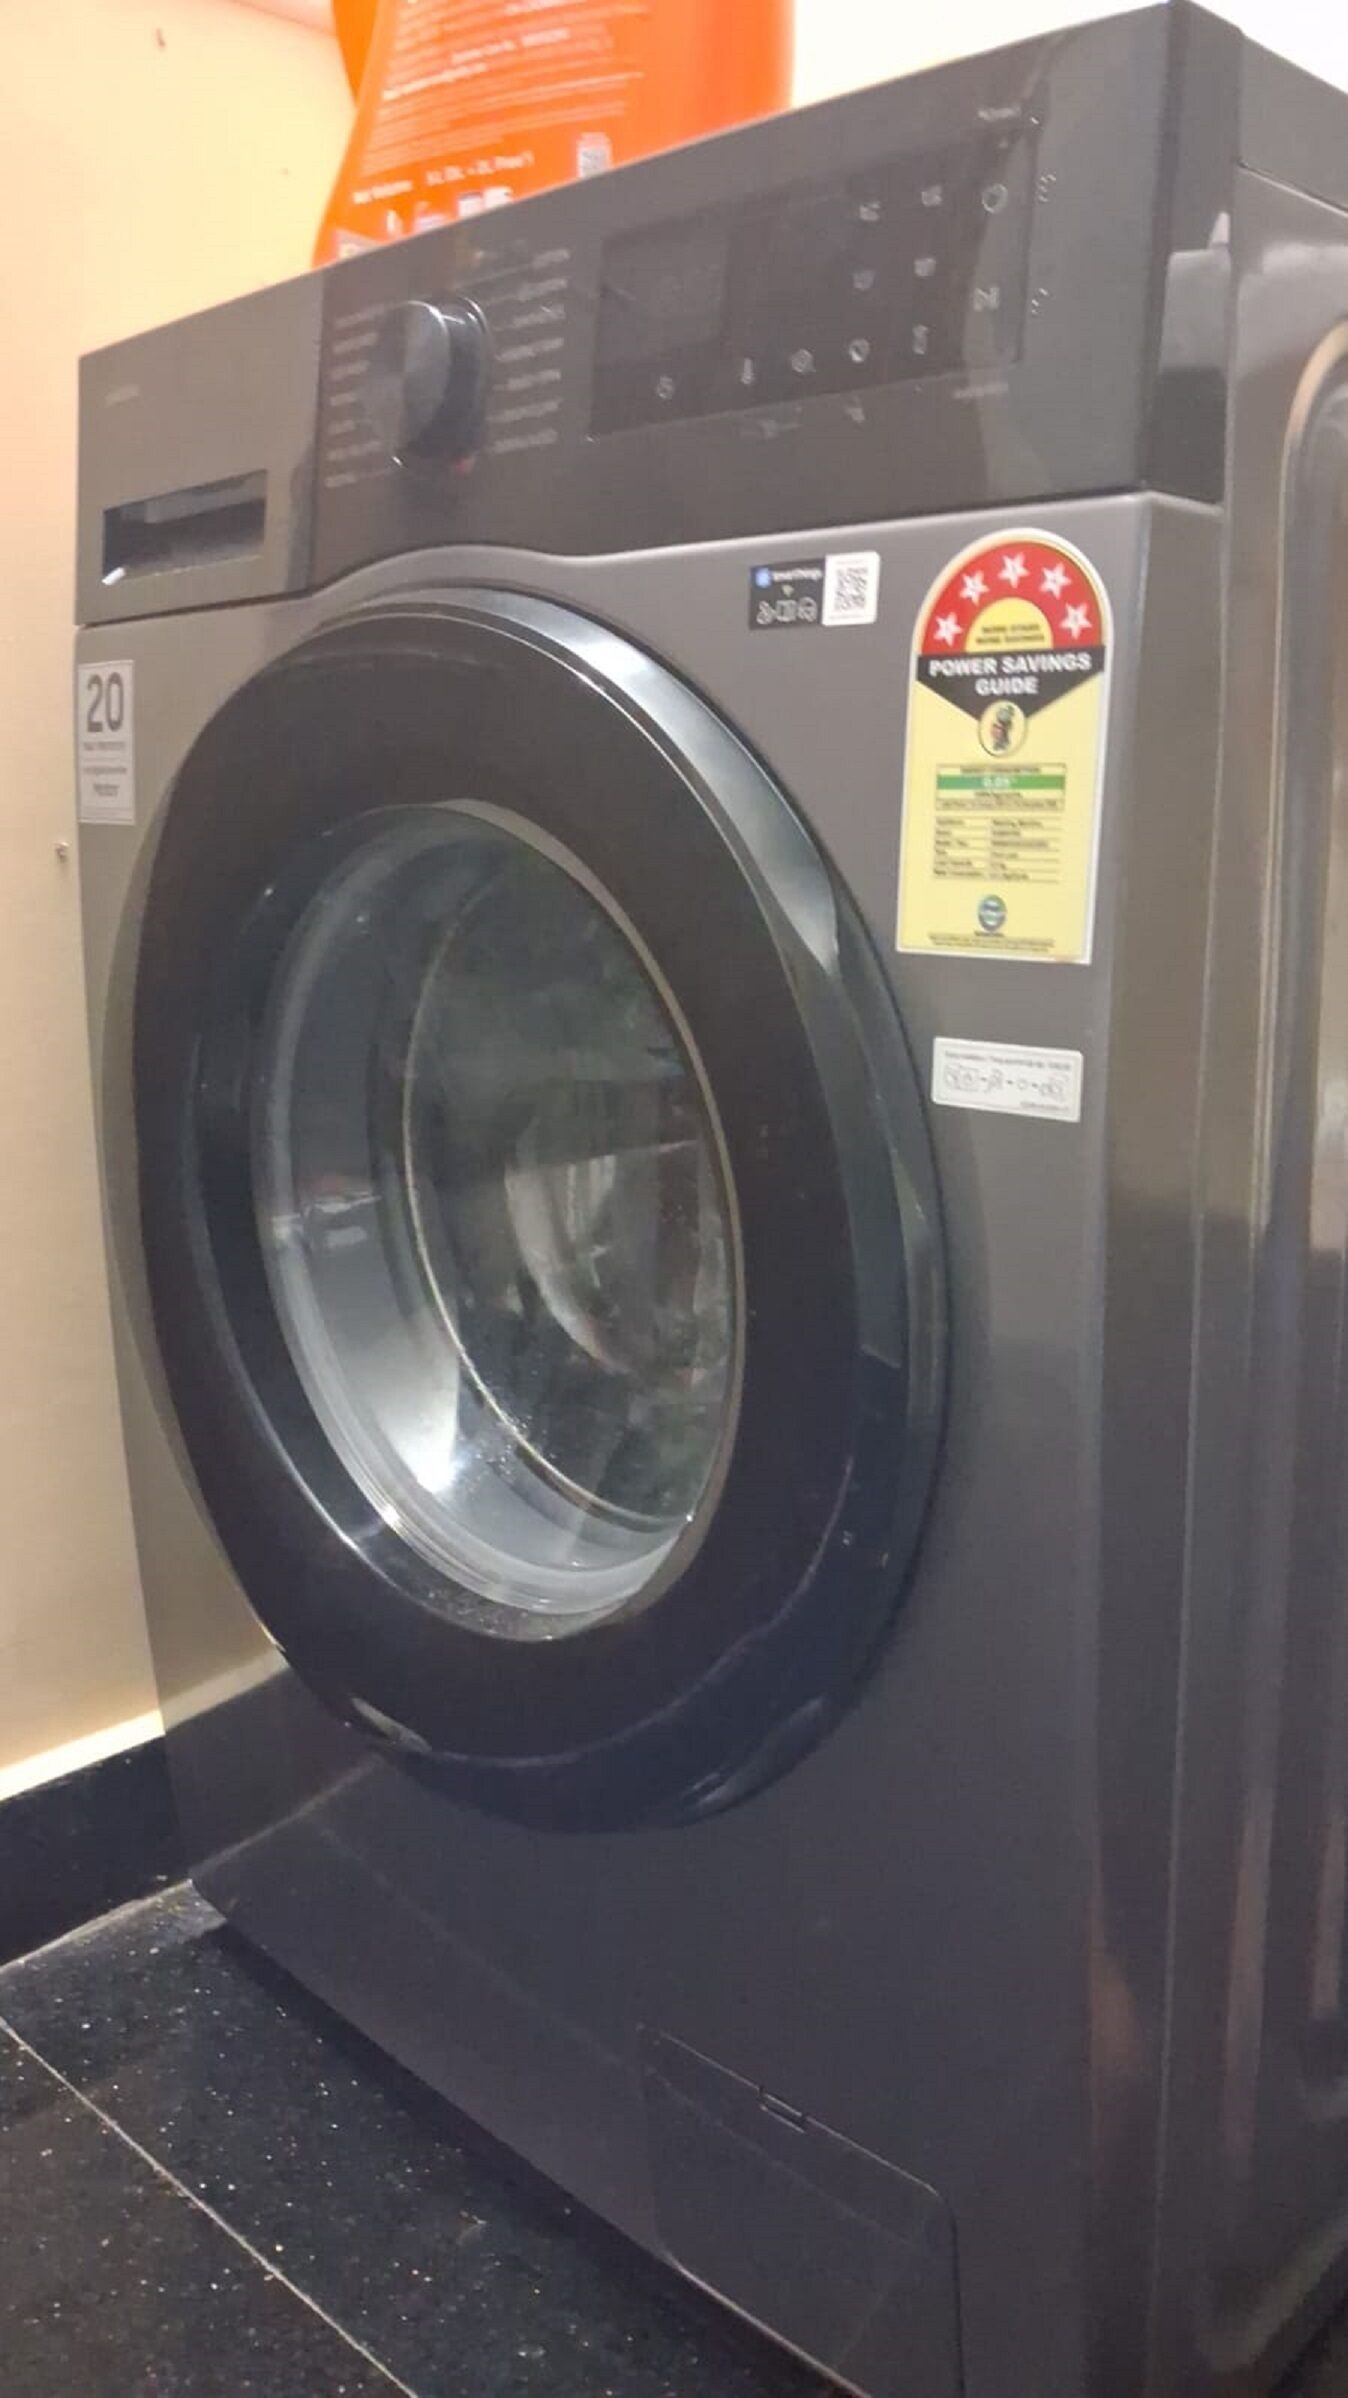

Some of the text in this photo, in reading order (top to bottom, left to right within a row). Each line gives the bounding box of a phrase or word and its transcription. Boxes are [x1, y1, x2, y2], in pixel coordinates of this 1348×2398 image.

[929, 652, 1093, 677] POWER SAVINGS
[975, 676, 1039, 696] GUIDE
[87, 671, 124, 733] 20
